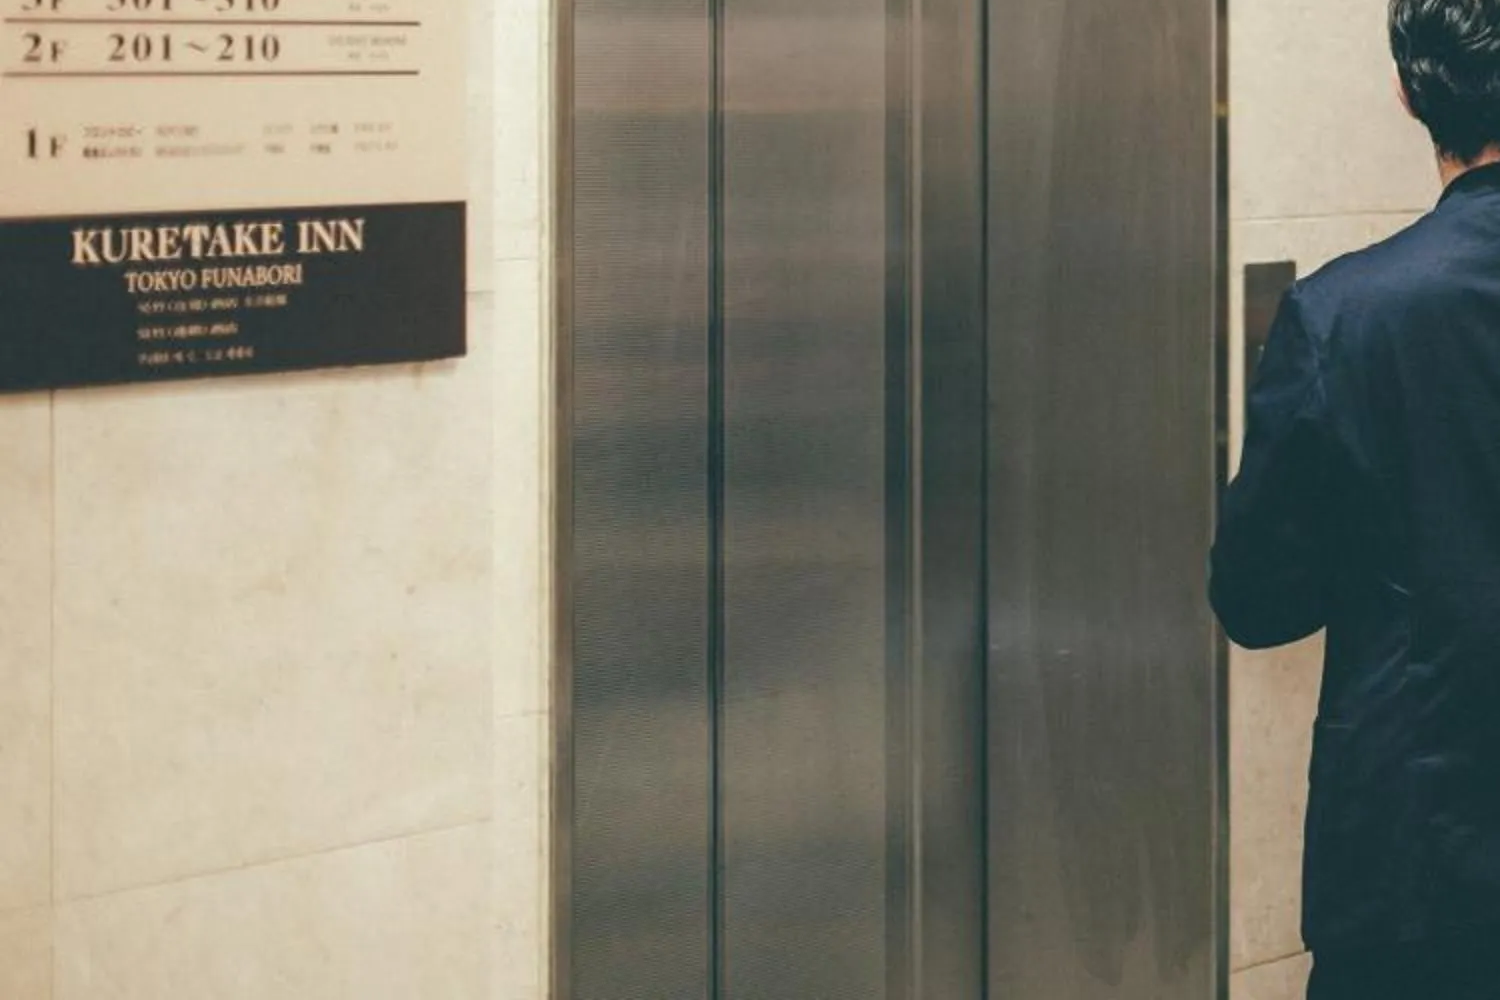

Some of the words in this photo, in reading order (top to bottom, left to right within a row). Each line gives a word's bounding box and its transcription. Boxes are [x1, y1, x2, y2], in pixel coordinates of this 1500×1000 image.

[21, 33, 68, 63] 2F
[24, 127, 68, 159] 1F
[71, 223, 284, 265] KURETAKE
[297, 218, 365, 252] INN
[124, 269, 197, 293] TOKYO
[200, 264, 303, 288] FUNABORI
